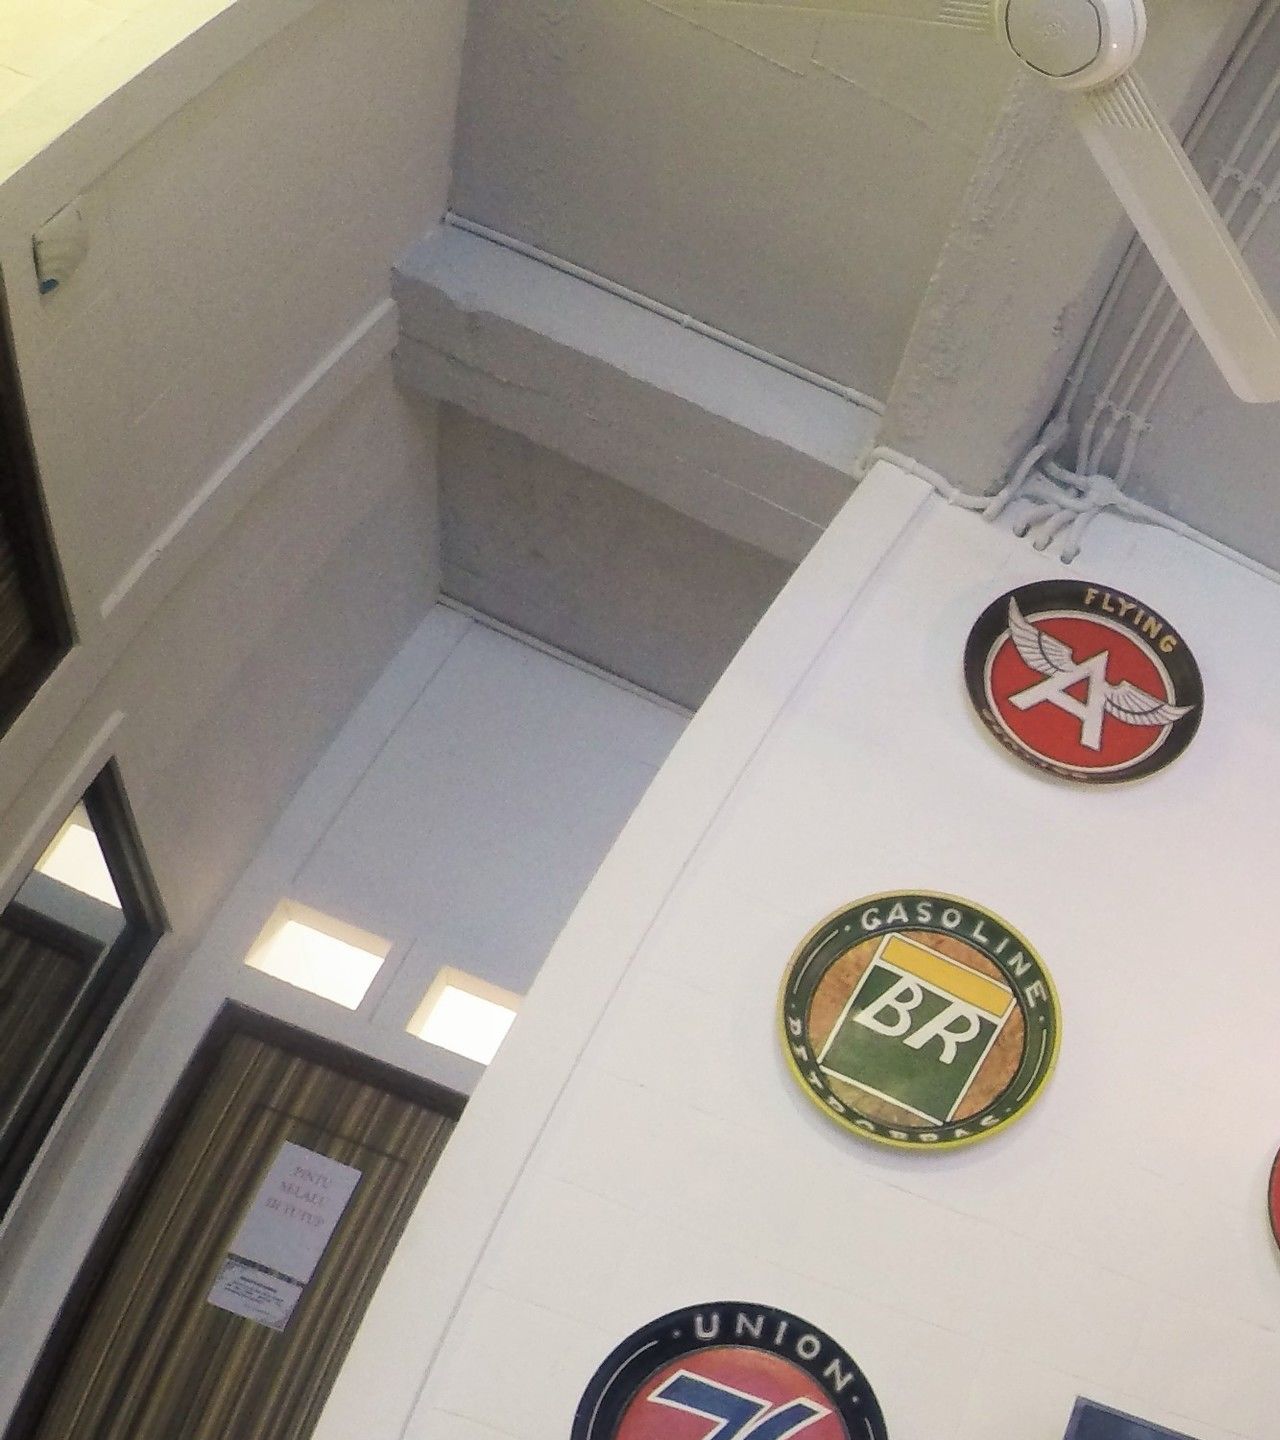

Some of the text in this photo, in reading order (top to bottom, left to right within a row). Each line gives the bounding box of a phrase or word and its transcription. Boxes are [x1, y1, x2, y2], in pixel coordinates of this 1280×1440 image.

[1083, 588, 1178, 654] FLYING
[861, 902, 1047, 1008] GASOLINE
[853, 975, 981, 1065] BR
[695, 1313, 855, 1392] UNION
